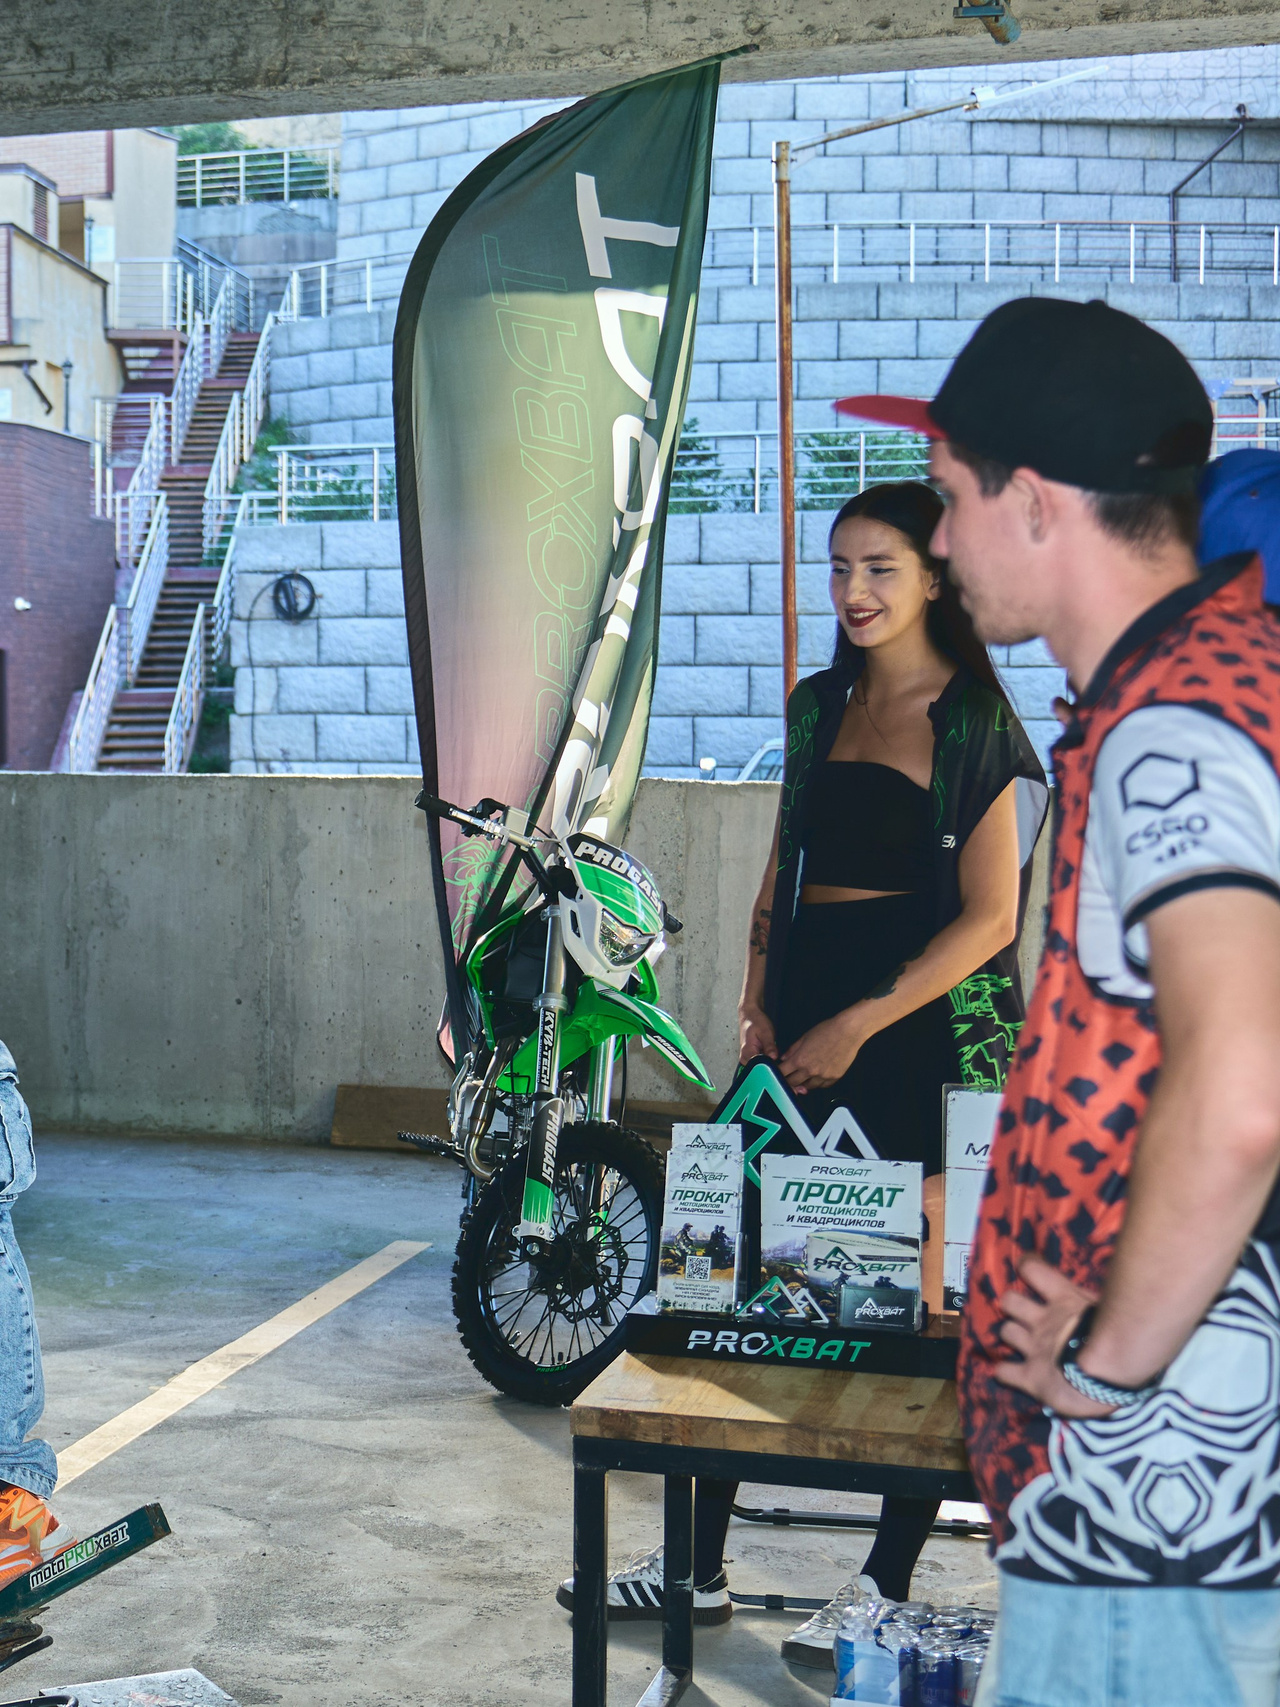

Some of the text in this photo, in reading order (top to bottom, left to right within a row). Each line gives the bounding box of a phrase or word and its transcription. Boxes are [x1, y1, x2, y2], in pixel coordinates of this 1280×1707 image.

[810, 1165, 872, 1177] PROXBAT
[672, 1189, 734, 1204] ПРОКАТ
[780, 1181, 905, 1208] ПРОКАТ
[796, 1204, 878, 1218] МОТОЦИКЛОВ
[786, 1214, 886, 1229] И КВАДРОЦИКЛОВ
[814, 1258, 910, 1273] PROXBAT
[686, 1330, 871, 1362] PROXBAT
